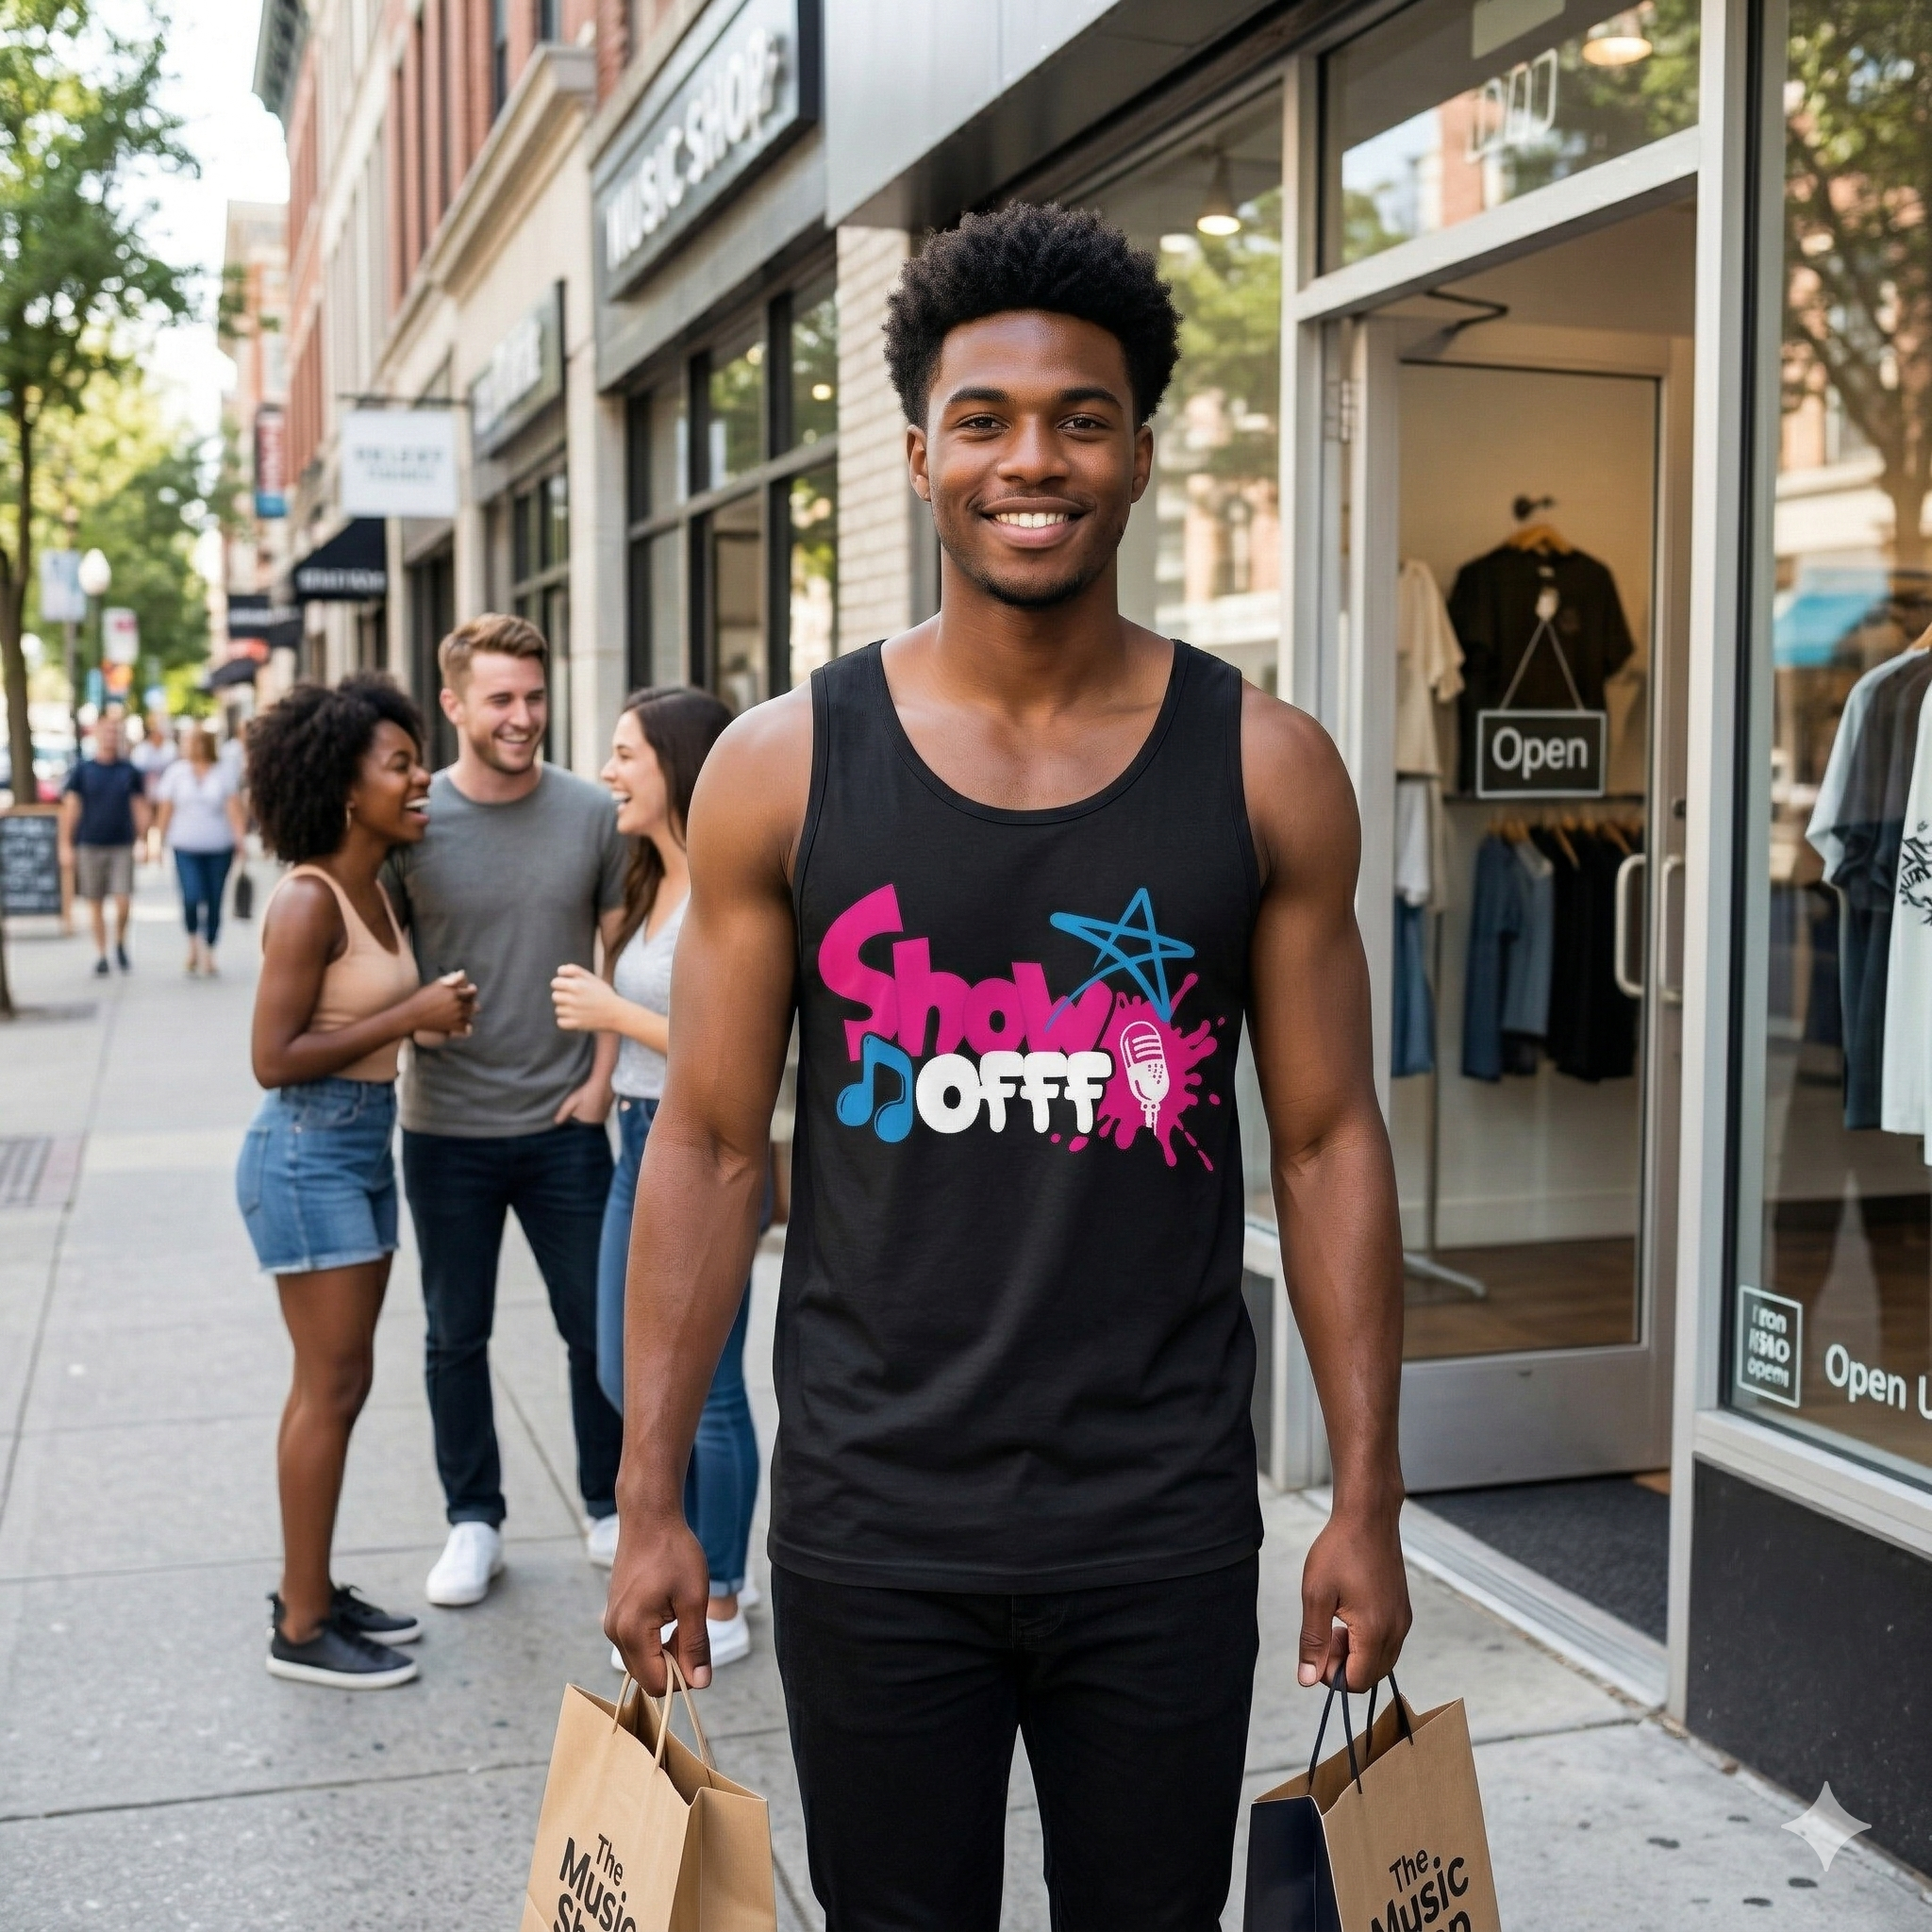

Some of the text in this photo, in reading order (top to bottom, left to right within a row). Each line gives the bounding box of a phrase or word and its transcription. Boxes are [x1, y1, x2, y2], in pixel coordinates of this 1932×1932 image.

[1492, 725, 1589, 780] Open
[818, 883, 1113, 1062] Show
[1824, 1343, 1907, 1412] Open
[596, 1833, 624, 1887] The
[1389, 1849, 1429, 1893] The
